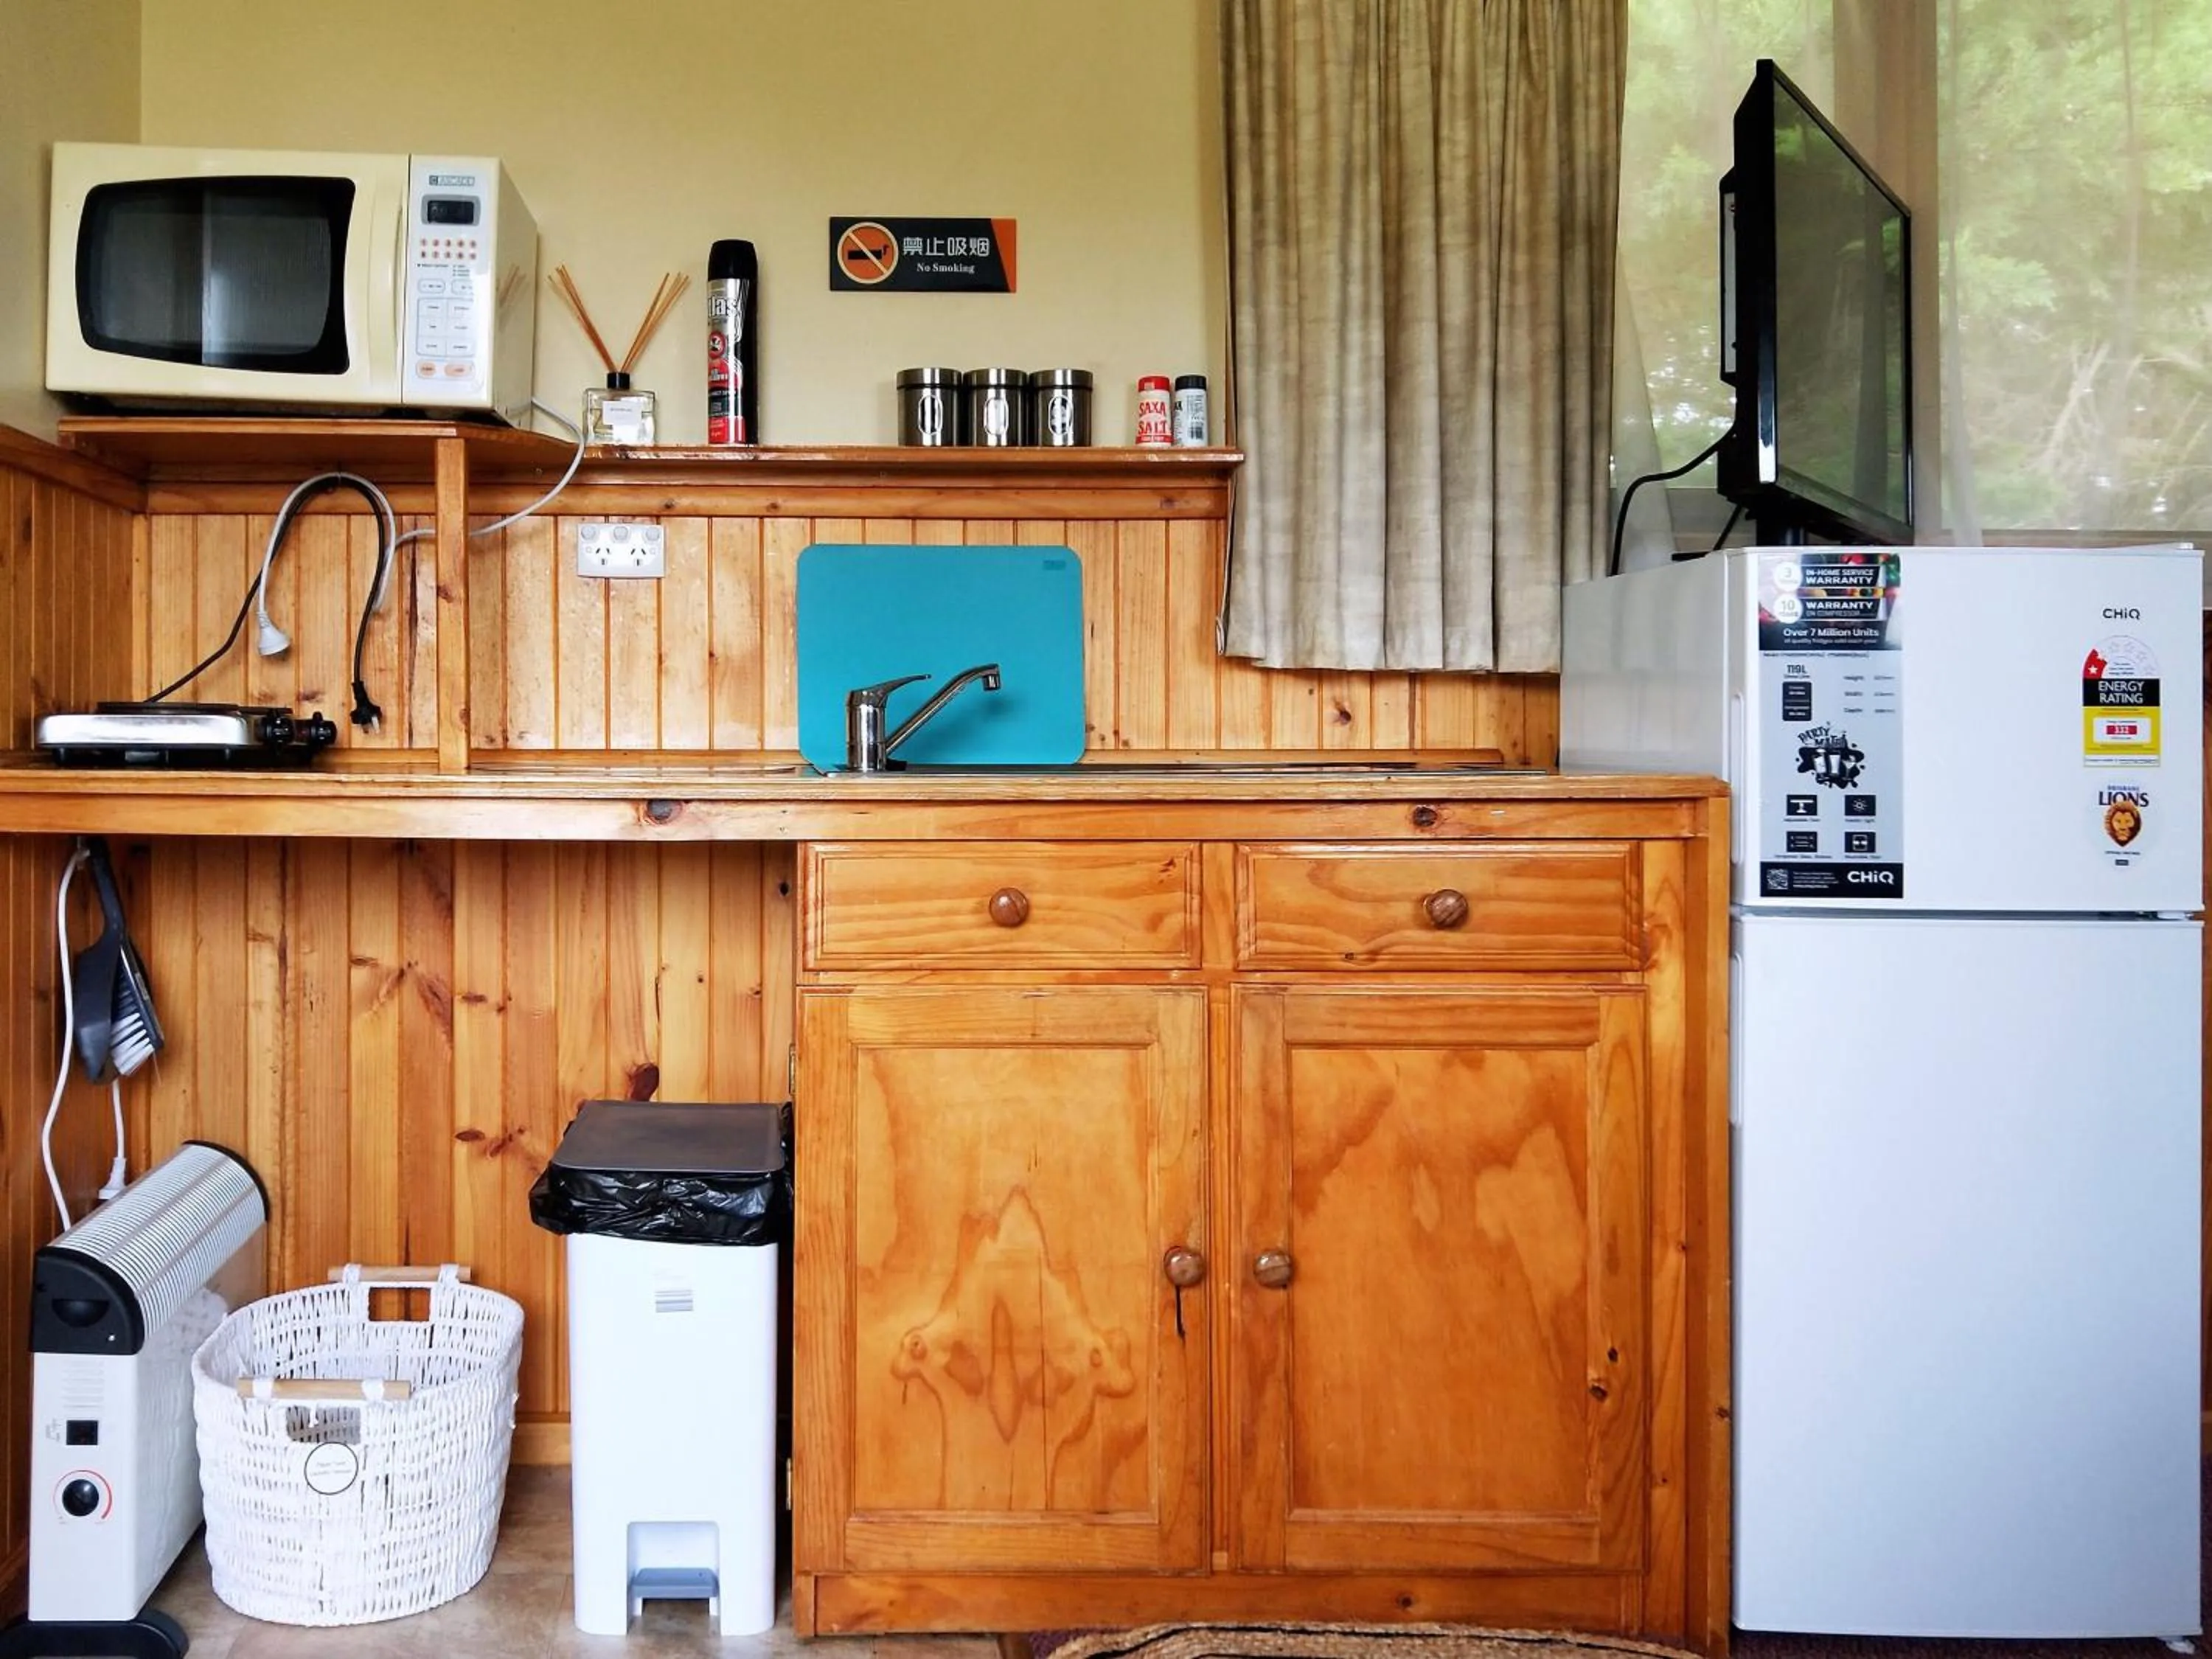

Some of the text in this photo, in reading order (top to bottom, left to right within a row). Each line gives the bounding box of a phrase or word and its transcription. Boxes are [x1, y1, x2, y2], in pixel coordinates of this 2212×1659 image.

[902, 237, 990, 257] 禁止吸烟
[917, 262, 975, 274] No Smoking
[1138, 400, 1167, 417] SAXA
[1138, 420, 1168, 434] SALT
[1781, 599, 1795, 610] 10
[2102, 608, 2140, 620] CHiQ
[1783, 628, 1879, 636] Over 7 Million Units
[2098, 681, 2145, 692] ENERGY
[2099, 692, 2144, 703] RATING
[2098, 791, 2149, 807] LIONS
[1847, 870, 1894, 885] CHiQ
